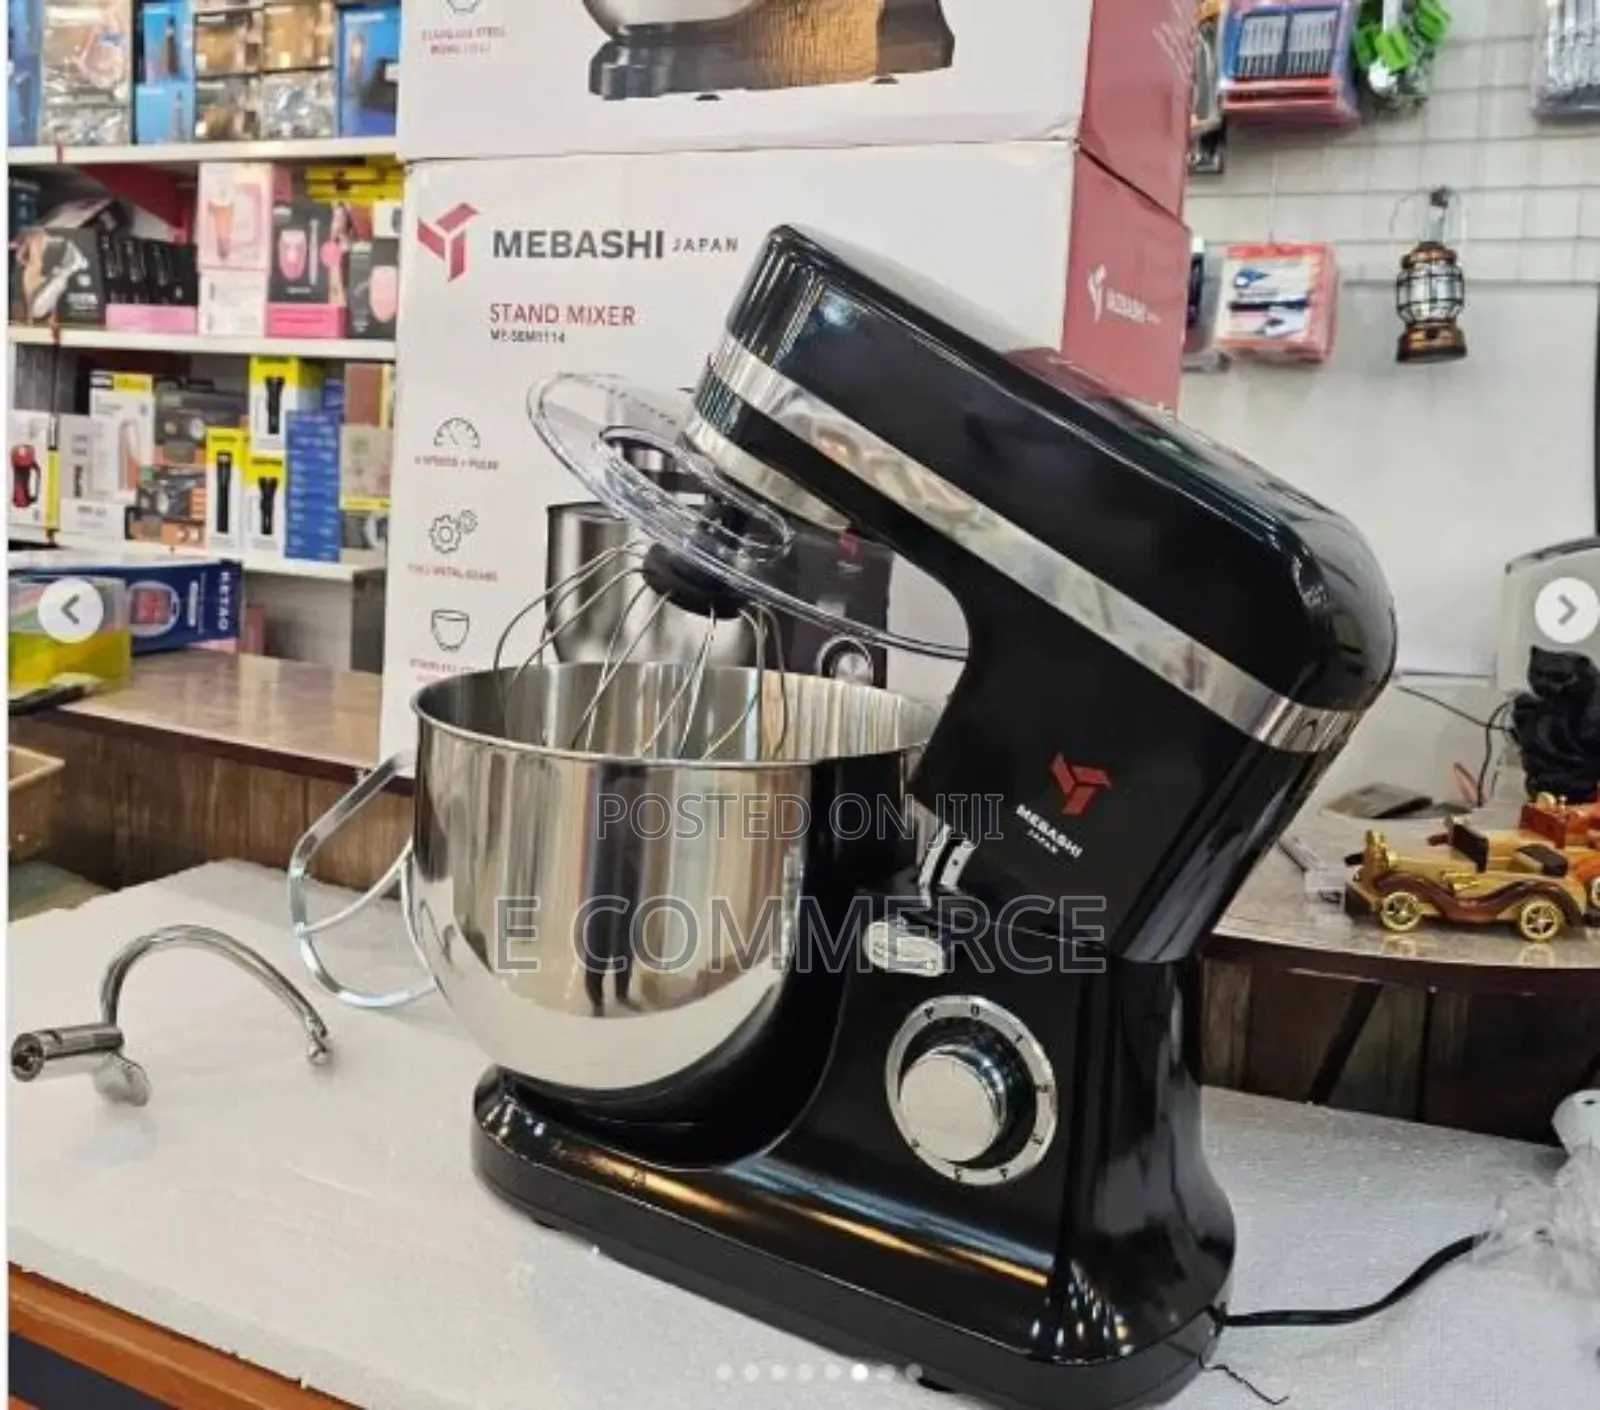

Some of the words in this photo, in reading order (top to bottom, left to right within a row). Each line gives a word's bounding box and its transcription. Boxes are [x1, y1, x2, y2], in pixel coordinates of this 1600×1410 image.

[493, 229, 666, 259] MEBASHI
[672, 238, 739, 253] JAPAN
[489, 302, 560, 325] STAND
[566, 304, 637, 327] MIXER
[1016, 803, 1084, 858] MEBASHI
